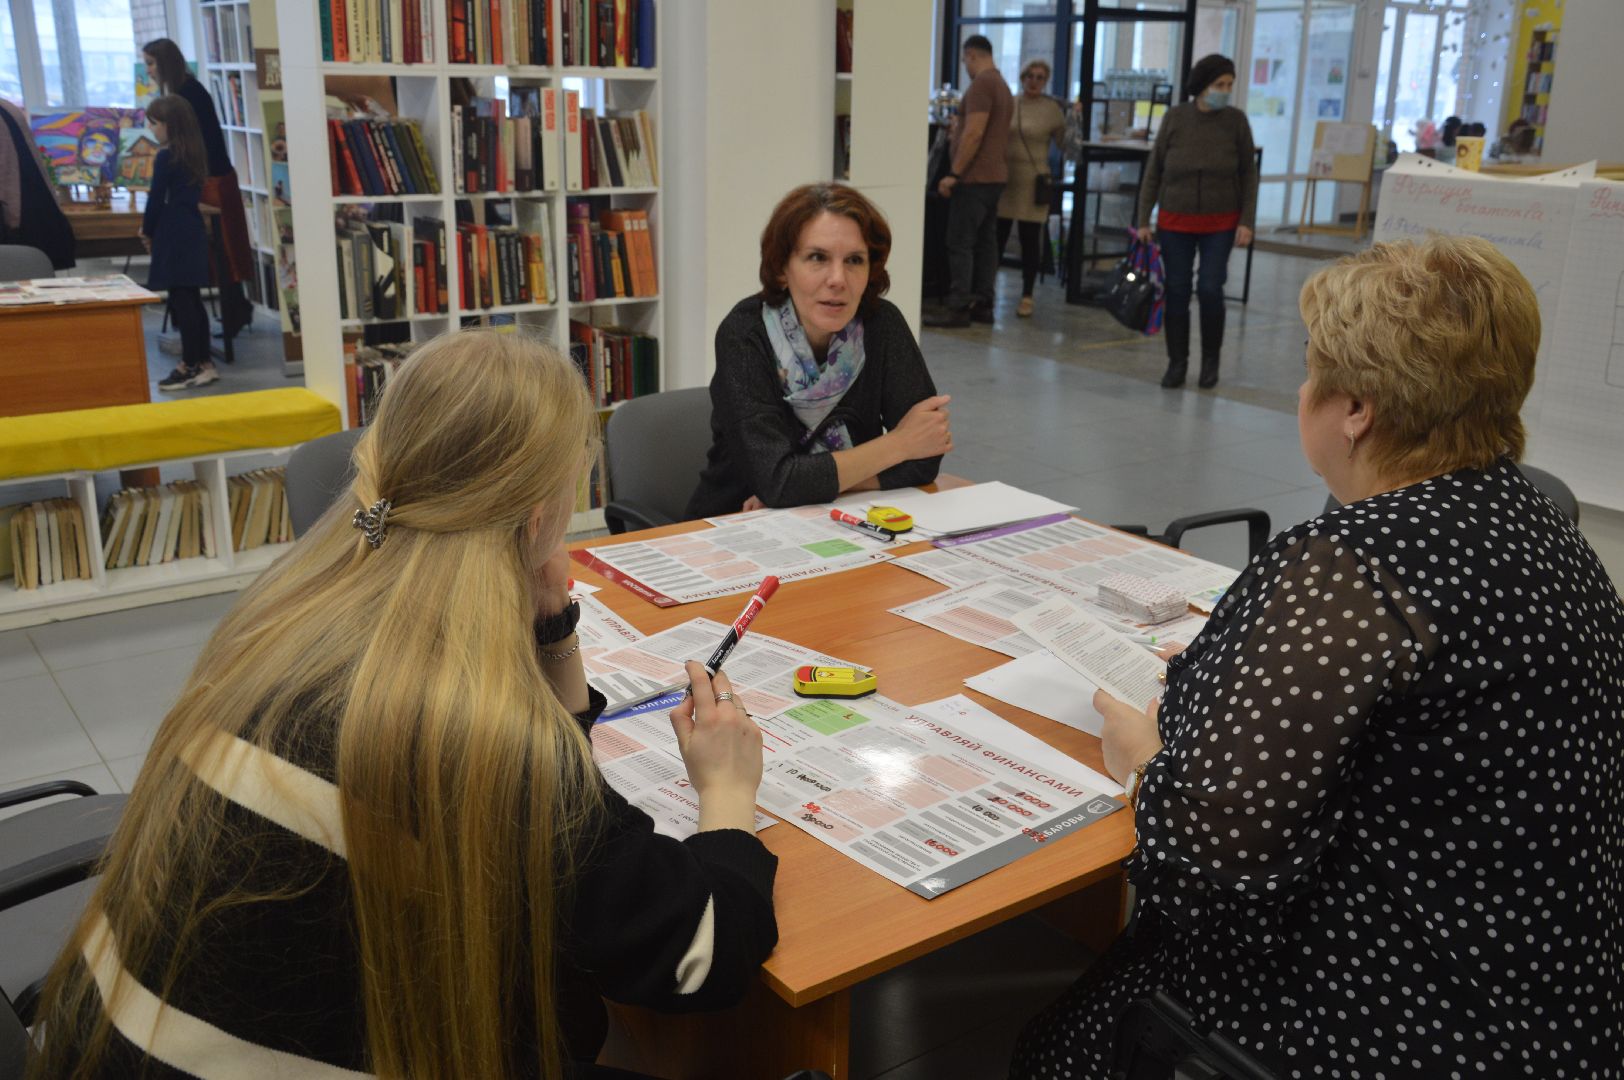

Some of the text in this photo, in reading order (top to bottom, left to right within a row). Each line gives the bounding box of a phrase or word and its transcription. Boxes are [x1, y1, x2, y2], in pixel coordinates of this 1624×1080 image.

[905, 714, 1084, 798] УПРАВЛЯЙ ФИНАНСАМИ
[1037, 813, 1086, 842] БАРОВЫ
